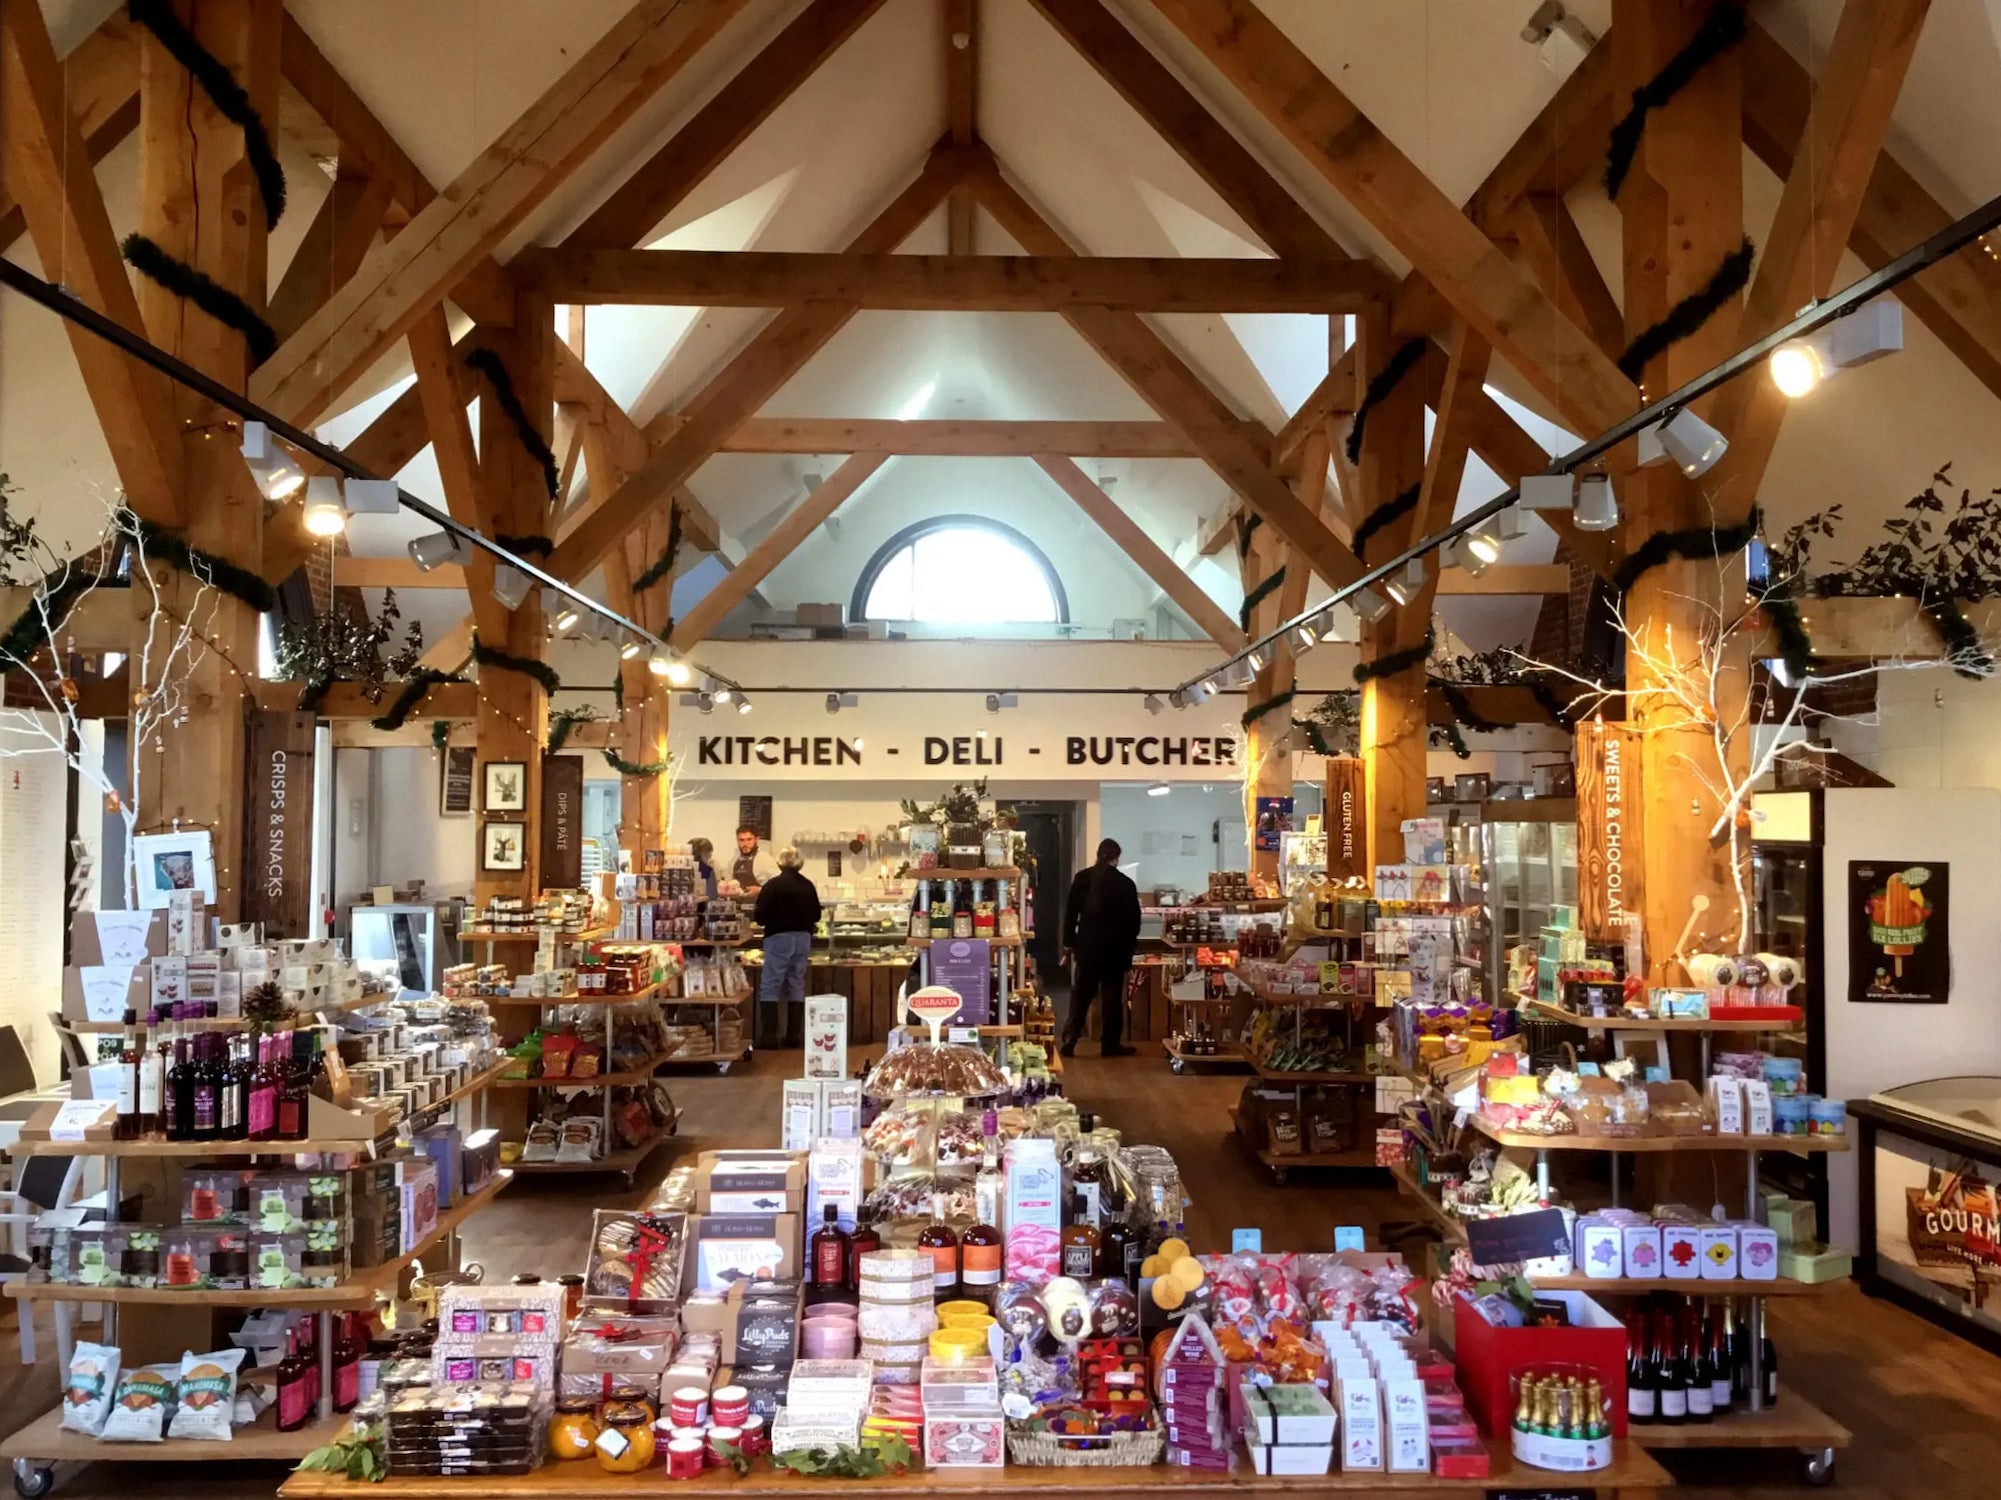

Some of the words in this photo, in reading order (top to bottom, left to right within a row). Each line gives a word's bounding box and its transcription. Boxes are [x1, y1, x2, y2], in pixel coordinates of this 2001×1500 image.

[698, 736, 861, 766] KITCHEN
[924, 736, 1003, 766] DELI
[1066, 736, 1237, 766] BUTCHER
[270, 750, 287, 810] CRISPS
[1604, 739, 1621, 803] SWEETS
[557, 792, 568, 816] DIPS
[1342, 791, 1352, 831] GLUTEN
[1605, 807, 1621, 819] &
[270, 814, 285, 825] &
[556, 826, 569, 851] PÂTÉ
[1343, 833, 1353, 859] FREE
[268, 829, 285, 897] SNACKS
[1605, 822, 1623, 927] CHOCOLATE
[910, 997, 959, 1008] QUARANTA
[1963, 1251, 1983, 1265] MORE
[741, 1327, 790, 1345] LillyPuds
